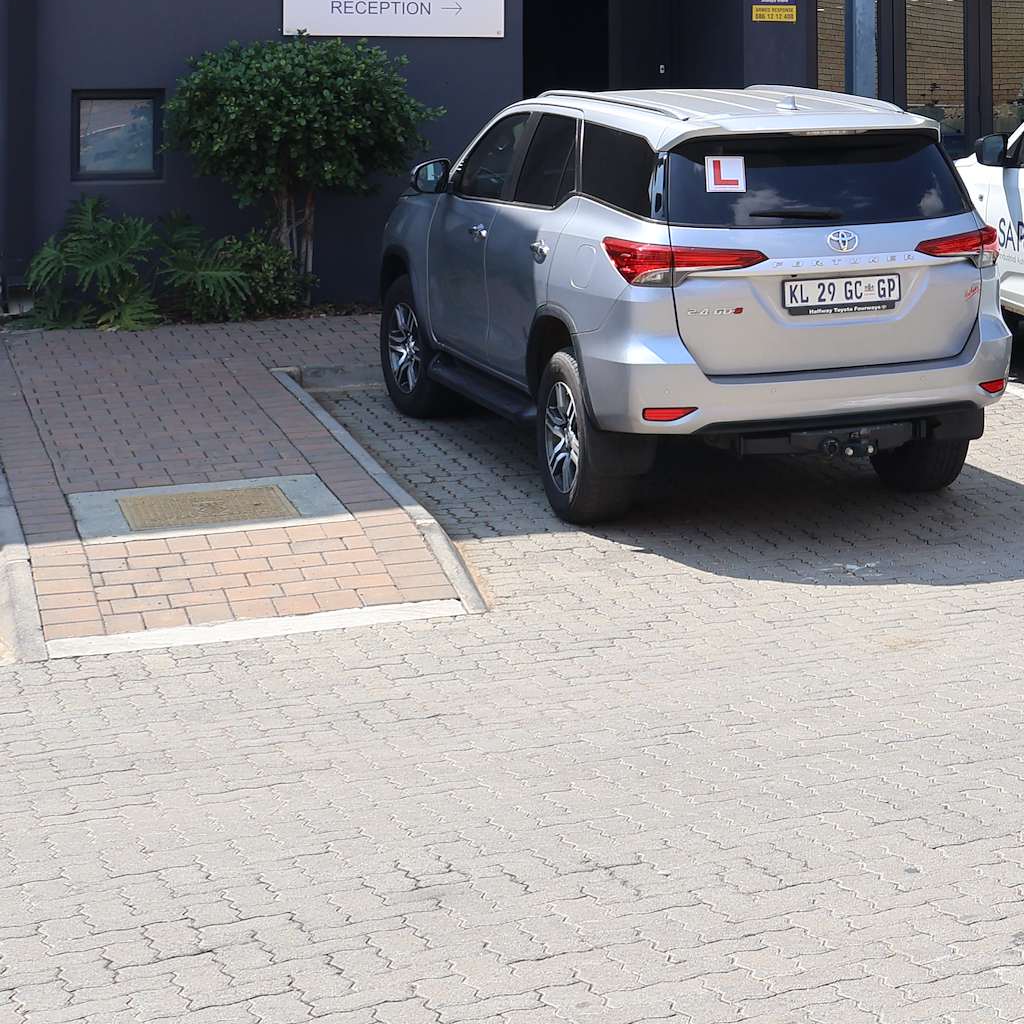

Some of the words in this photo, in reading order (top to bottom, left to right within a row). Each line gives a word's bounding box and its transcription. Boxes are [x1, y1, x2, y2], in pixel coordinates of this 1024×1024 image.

[331, 0, 431, 15] RECEPTION
[713, 160, 739, 185] L
[789, 284, 808, 304] KL
[818, 282, 836, 302] 29
[844, 280, 863, 300] GC
[877, 278, 895, 298] GP
